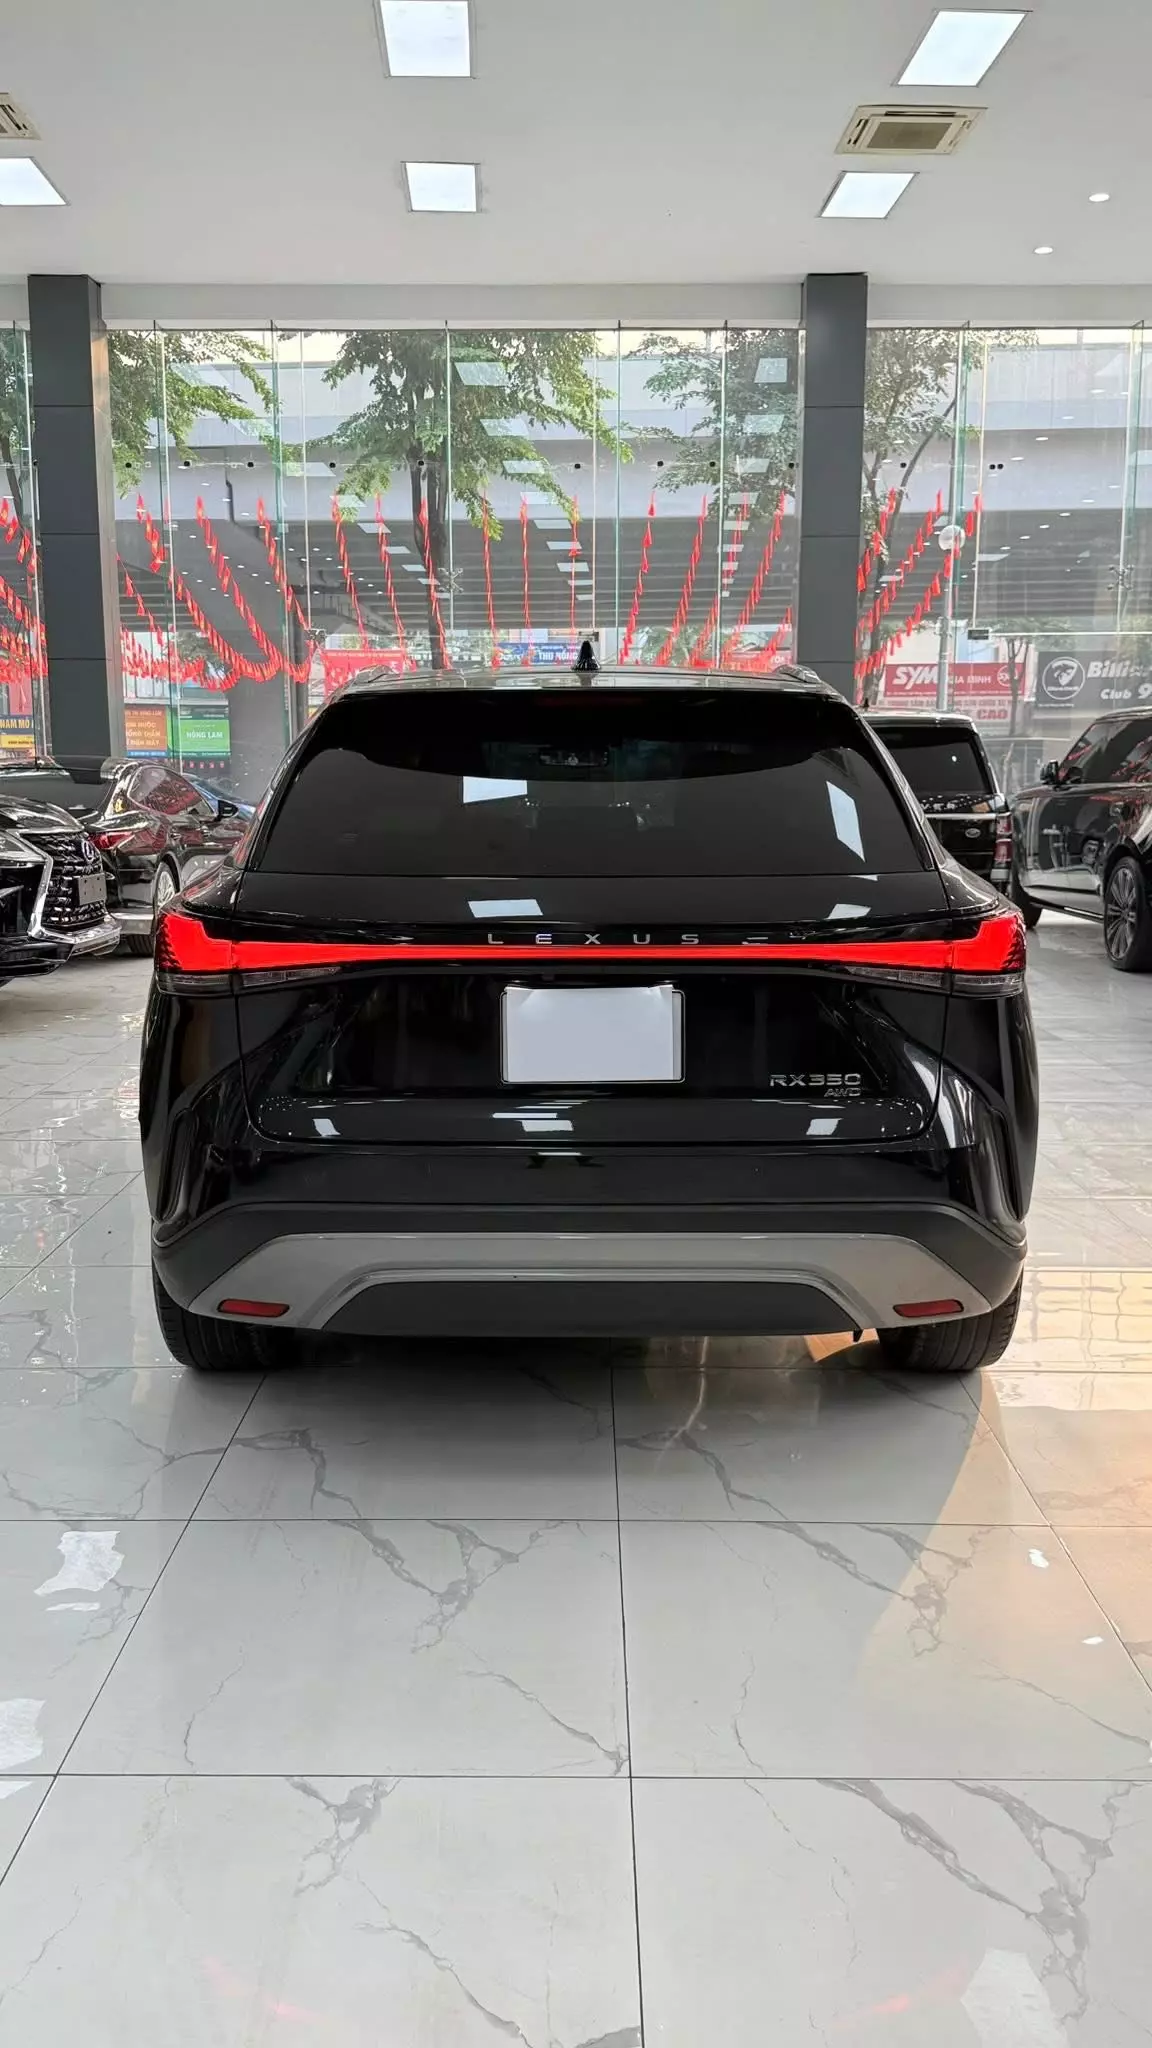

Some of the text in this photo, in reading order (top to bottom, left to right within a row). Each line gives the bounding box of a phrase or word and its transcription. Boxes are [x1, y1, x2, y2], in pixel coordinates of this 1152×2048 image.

[892, 666, 938, 690] SYM
[1100, 688, 1132, 700] Club
[487, 933, 699, 945] LEXUS
[769, 1073, 861, 1087] RX350
